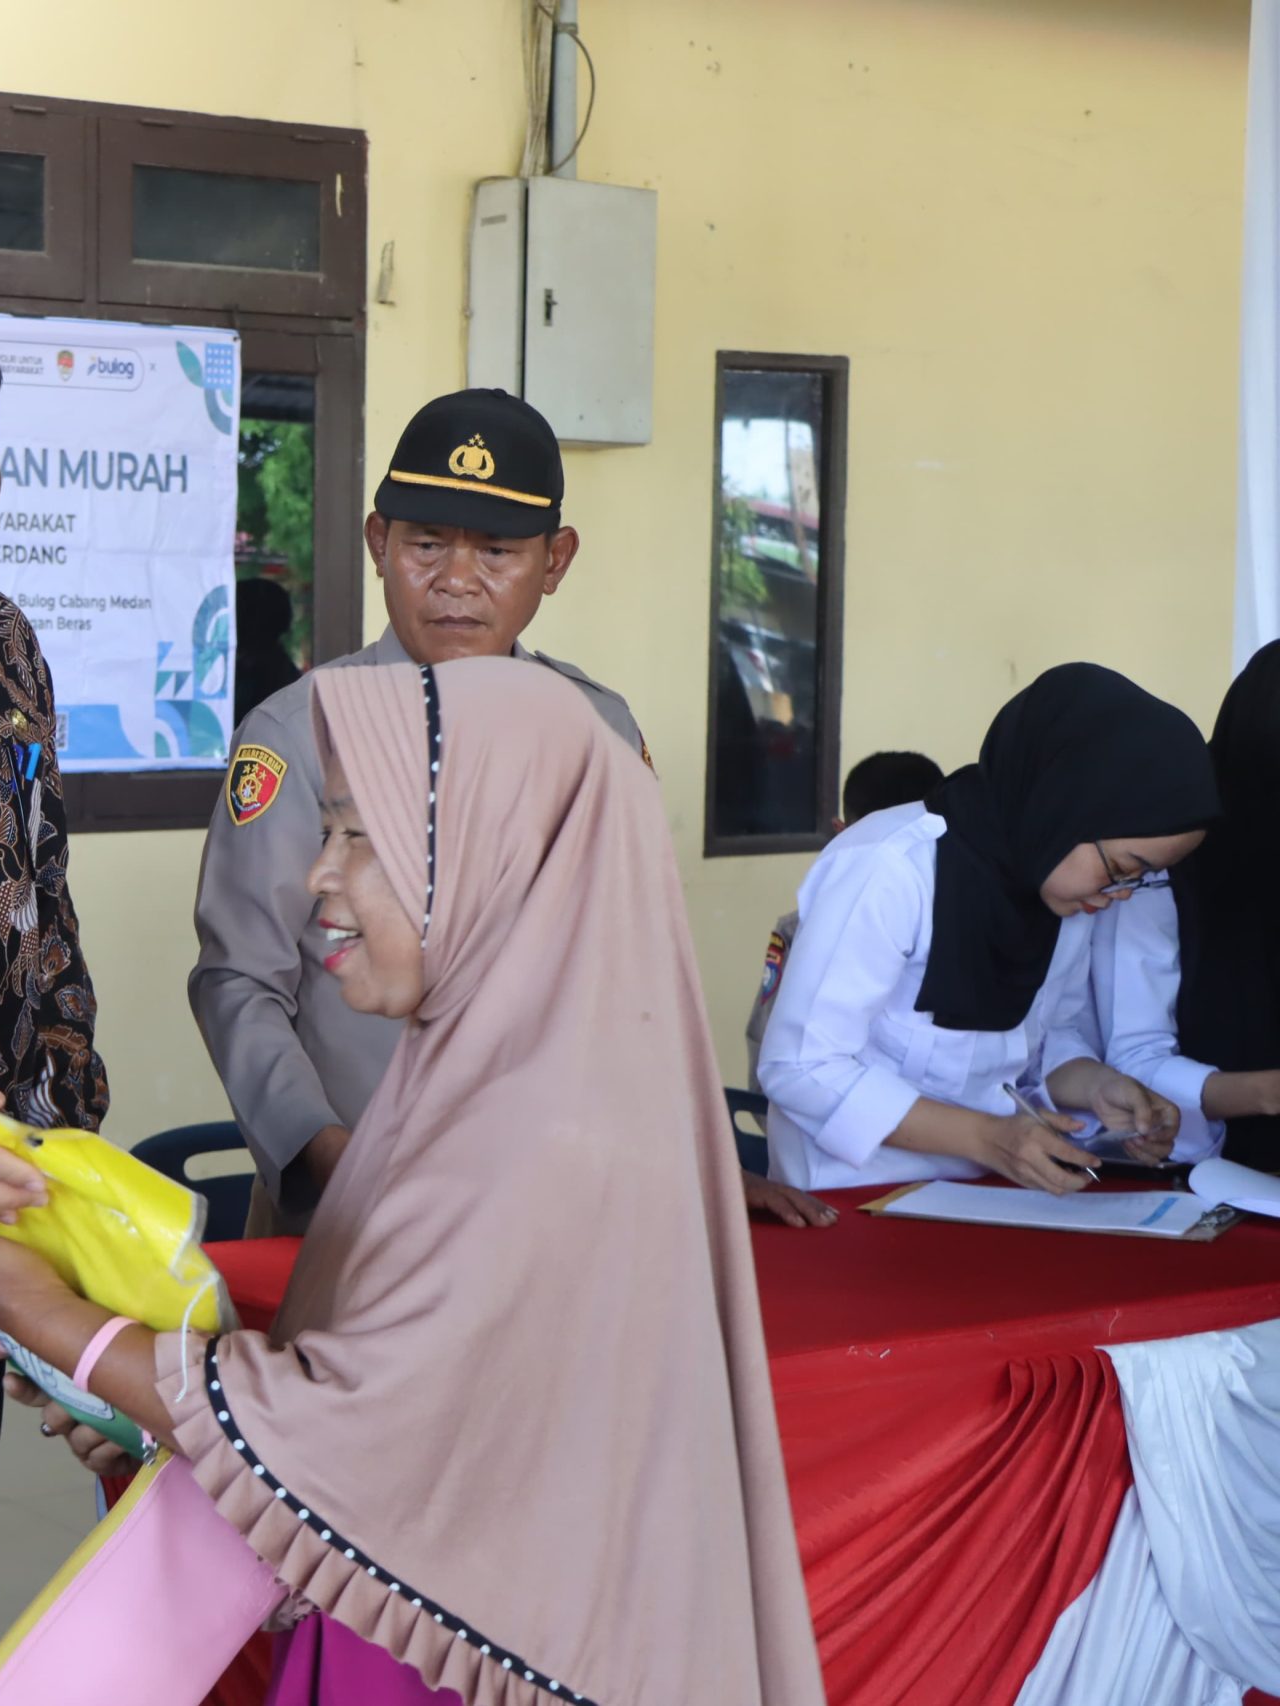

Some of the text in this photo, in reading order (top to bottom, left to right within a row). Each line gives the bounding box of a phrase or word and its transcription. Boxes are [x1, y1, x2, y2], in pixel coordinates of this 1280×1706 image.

[97, 357, 134, 379] bulog
[59, 449, 188, 493] MURAH
[20, 594, 152, 612] Bulog Cabang Medan
[57, 617, 92, 631] Beras
